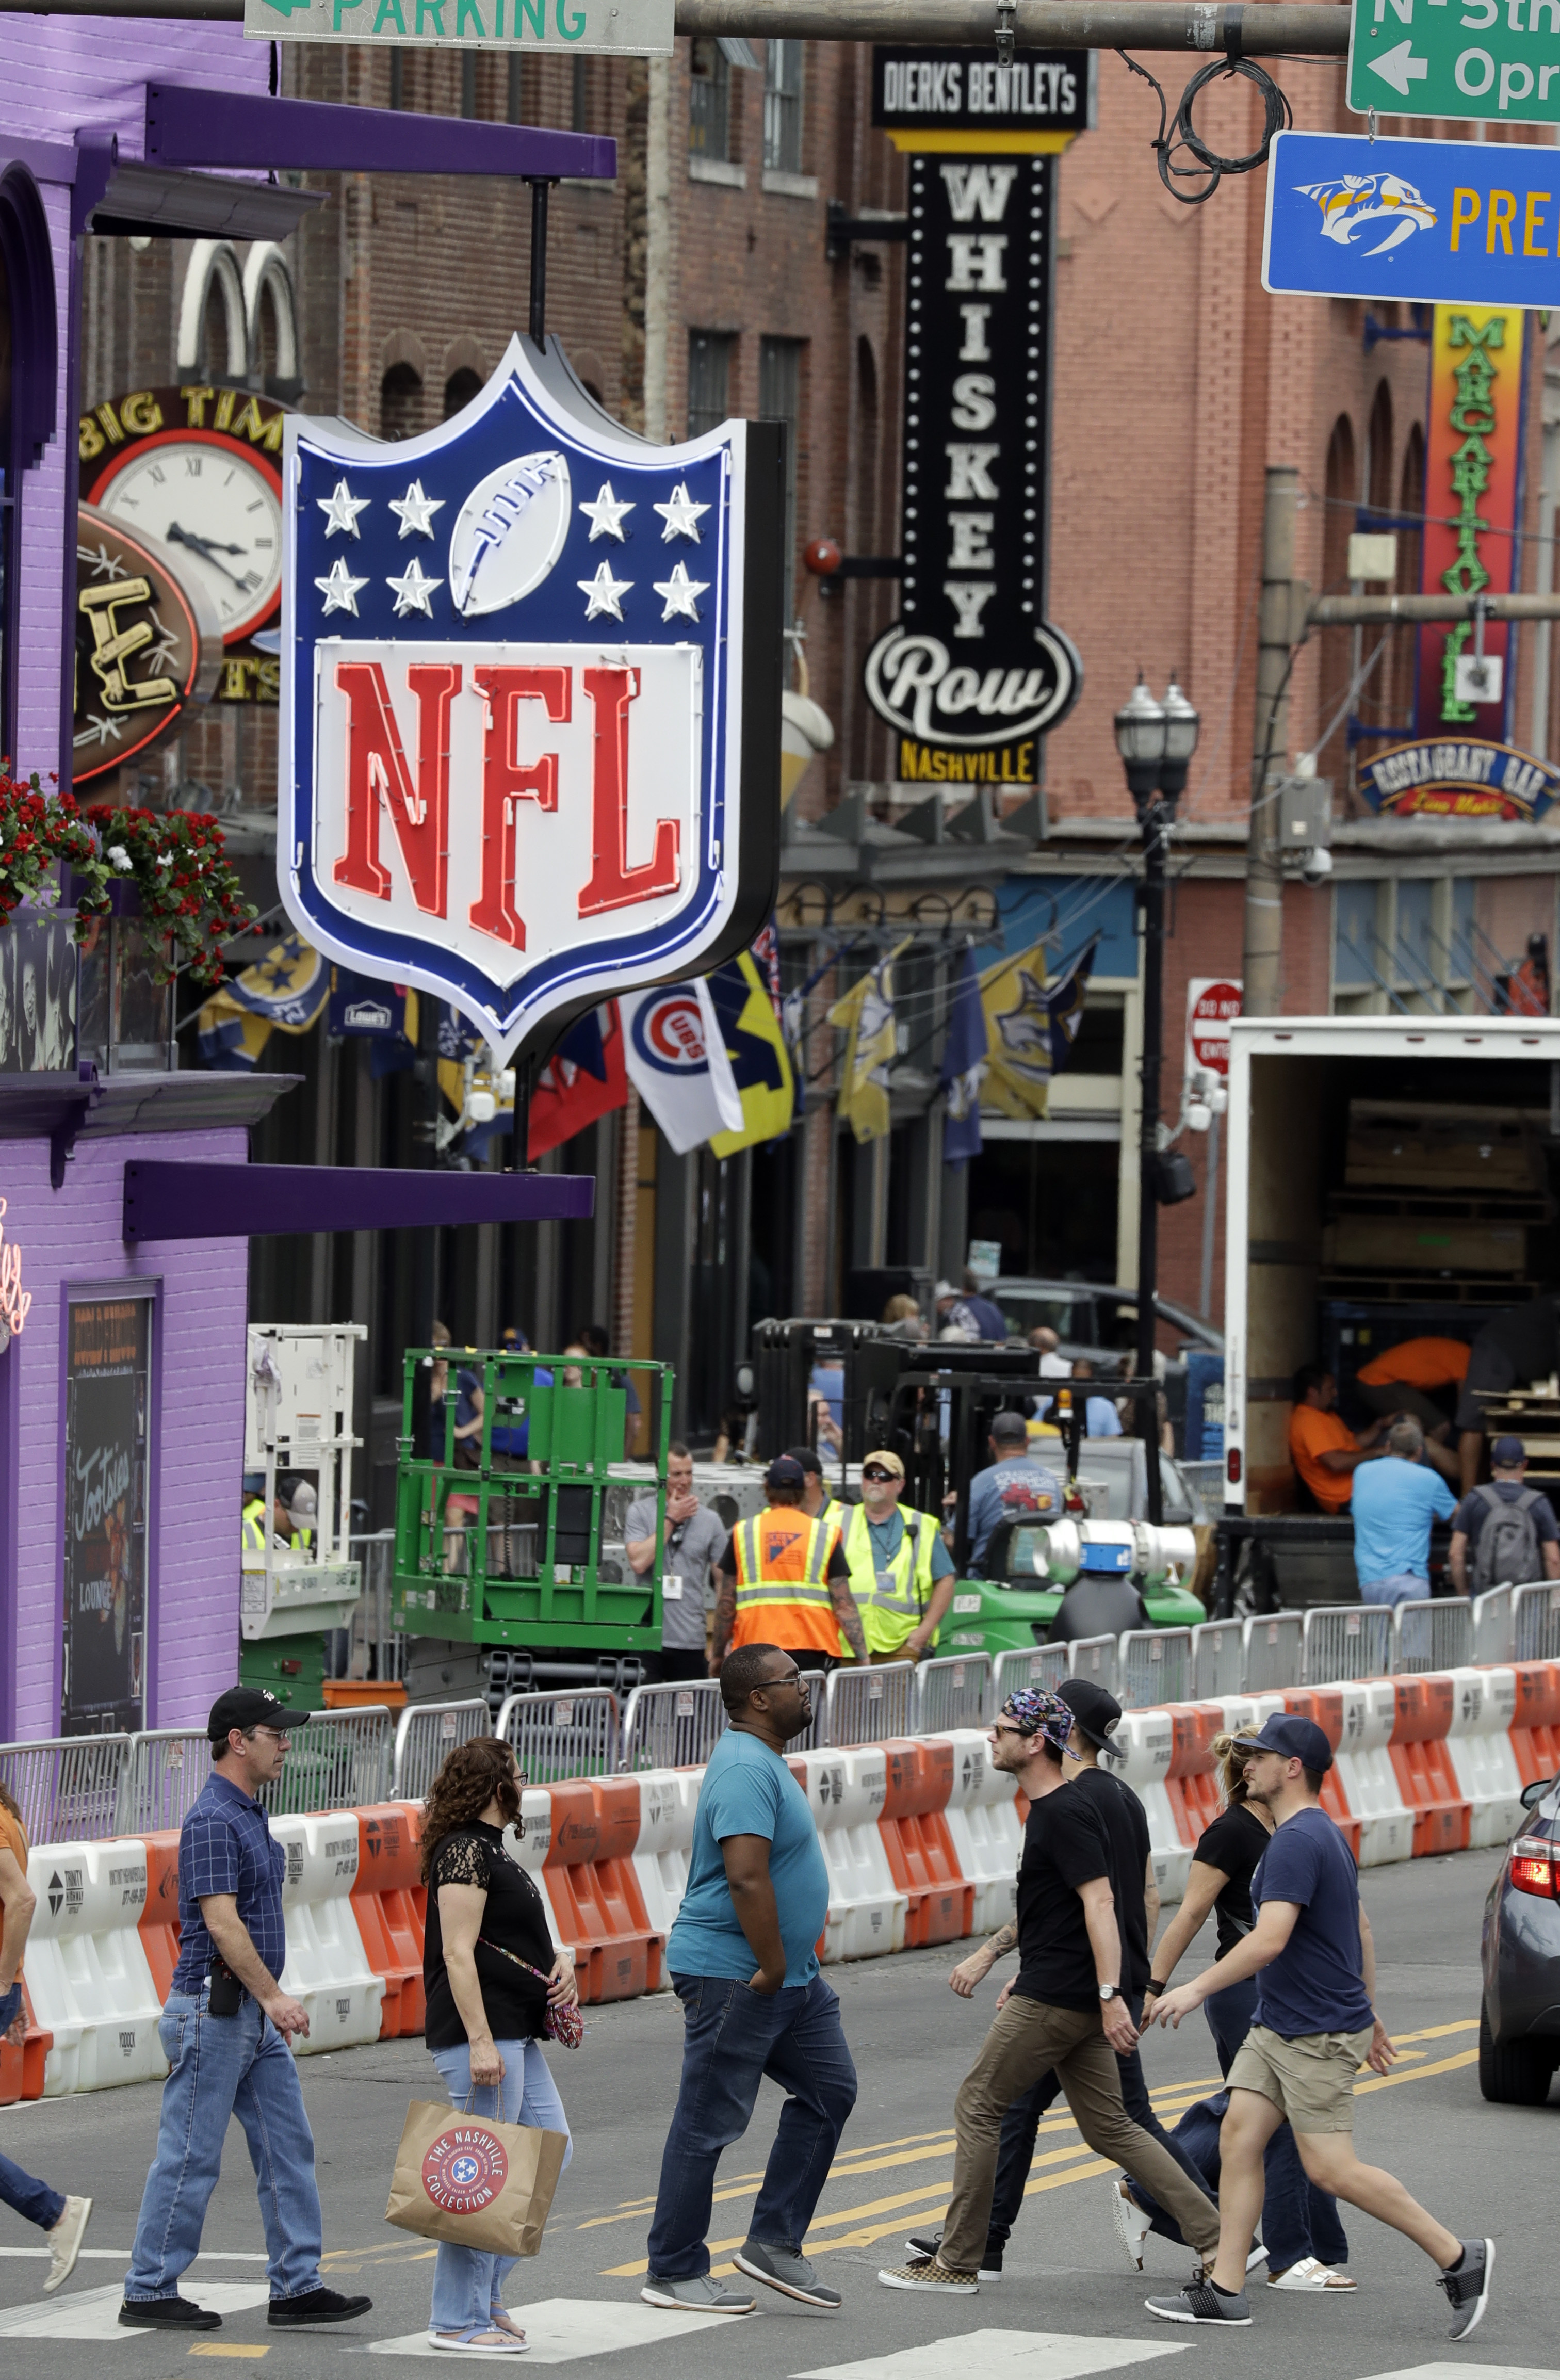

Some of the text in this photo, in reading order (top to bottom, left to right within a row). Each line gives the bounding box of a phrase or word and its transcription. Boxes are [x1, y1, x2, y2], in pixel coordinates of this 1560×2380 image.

[333, 0, 587, 40] PARKING
[883, 61, 961, 113] DIERKS
[1450, 187, 1560, 258] PRE
[79, 386, 283, 462] BIG TIM
[939, 164, 1018, 638] WHISKEY
[882, 635, 1052, 736] Row
[901, 740, 1034, 783] NASHVILLE
[332, 659, 681, 952] NFL
[1198, 999, 1241, 1017] DO NO
[1199, 1041, 1230, 1060] ENTE
[79, 1579, 112, 1613] LOUNGE
[427, 2130, 503, 2210] THE NASHVILLE COLLECTION
